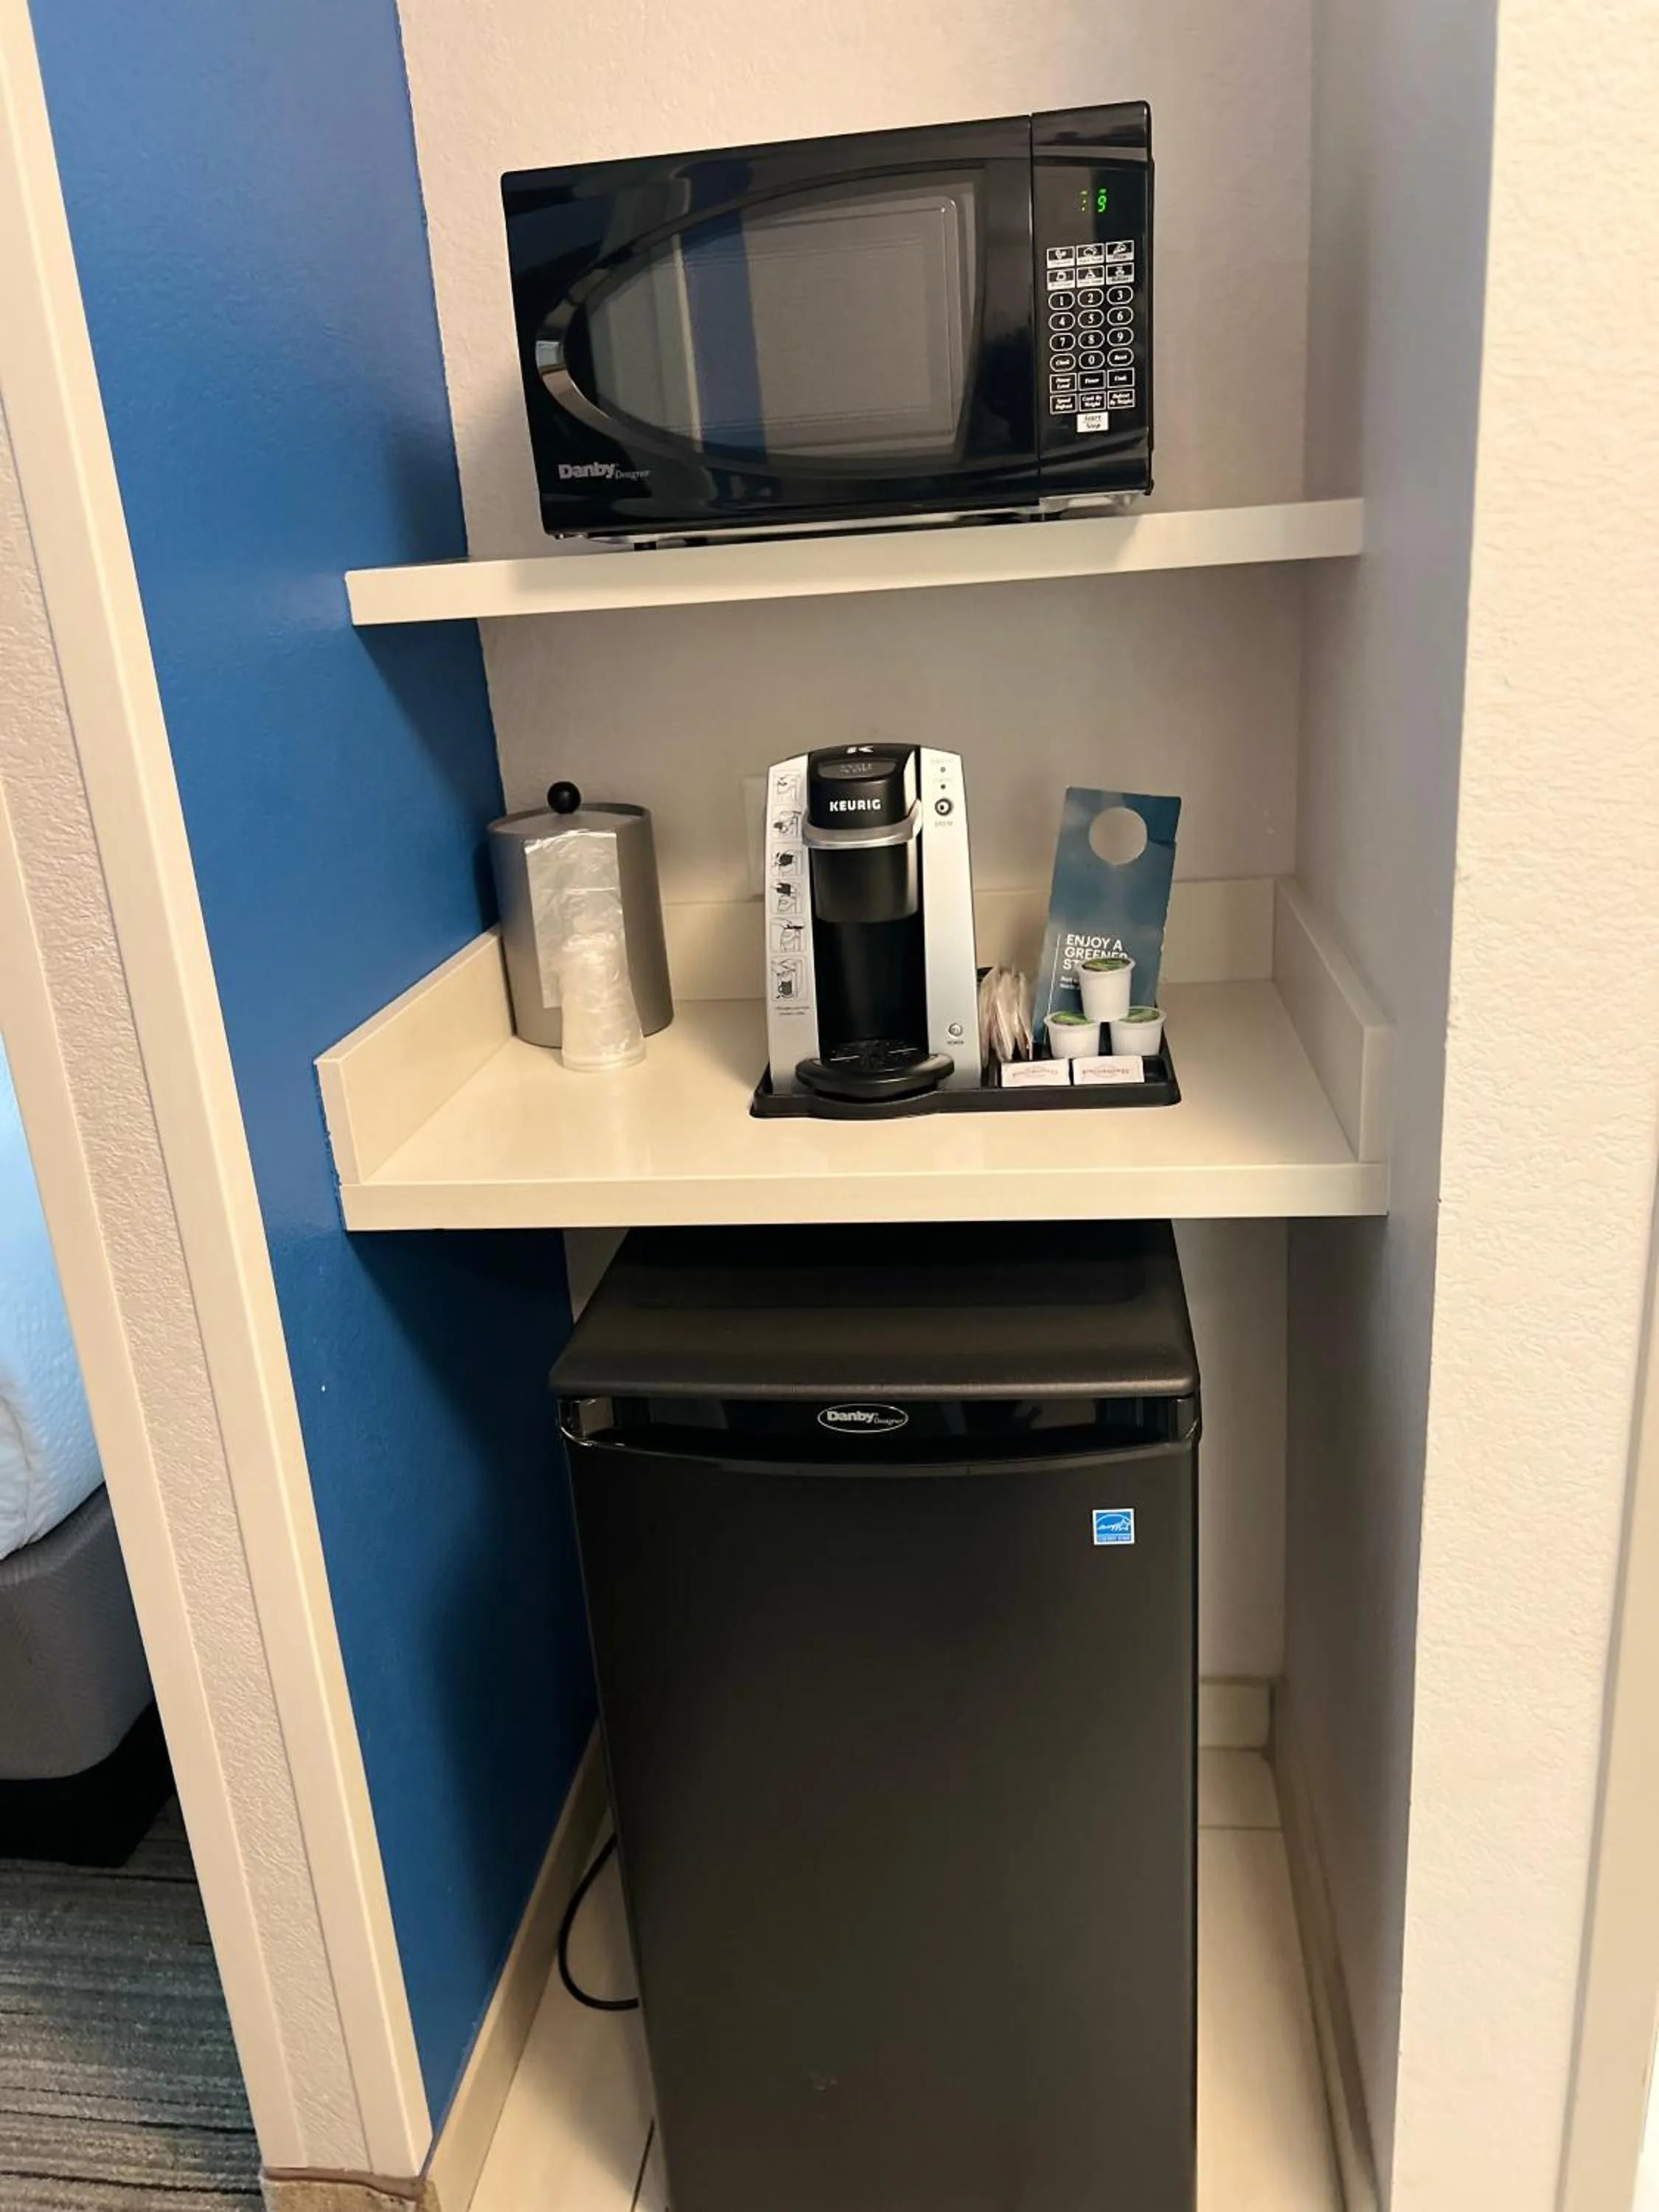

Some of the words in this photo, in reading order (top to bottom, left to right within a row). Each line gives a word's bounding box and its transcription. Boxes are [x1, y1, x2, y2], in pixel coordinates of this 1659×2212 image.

[1059, 296, 1064, 306] 1
[1087, 293, 1093, 303] 2
[1117, 290, 1123, 301] 3
[1059, 316, 1065, 327] 4
[1088, 313, 1095, 324] 5
[1117, 310, 1124, 321] 6
[1059, 337, 1065, 347] 7
[1088, 334, 1095, 344] 8
[1117, 332, 1124, 341] 9
[1088, 355, 1095, 365] 0
[558, 462, 615, 479] Danby
[830, 799, 881, 812] KEURIG
[1066, 934, 1110, 949] ENJOY
[1113, 939, 1123, 951] A
[827, 1411, 874, 1423] Danby
